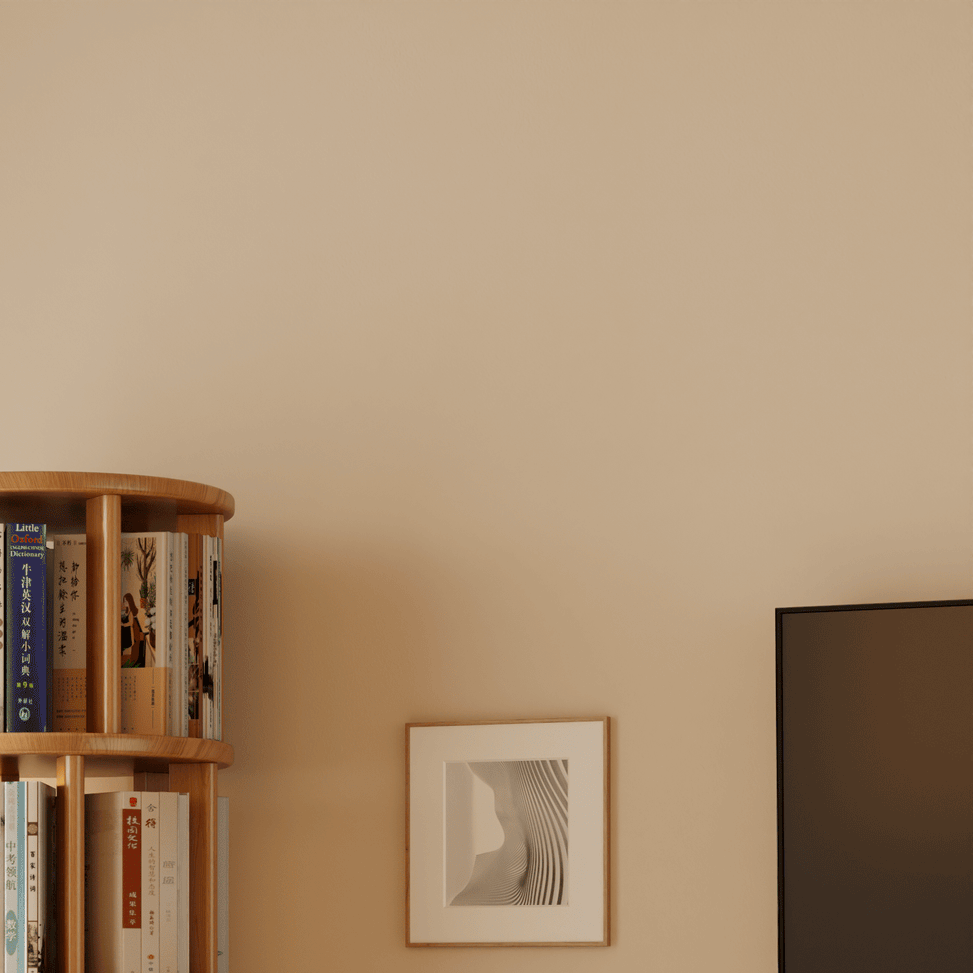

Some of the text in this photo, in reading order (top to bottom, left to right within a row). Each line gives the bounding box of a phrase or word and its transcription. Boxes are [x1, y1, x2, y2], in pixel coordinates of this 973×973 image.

[15, 523, 40, 533] Little
[10, 534, 43, 543] Oxford
[10, 551, 45, 560] Dictionary
[21, 563, 32, 676] 牛津英汉双解小词典
